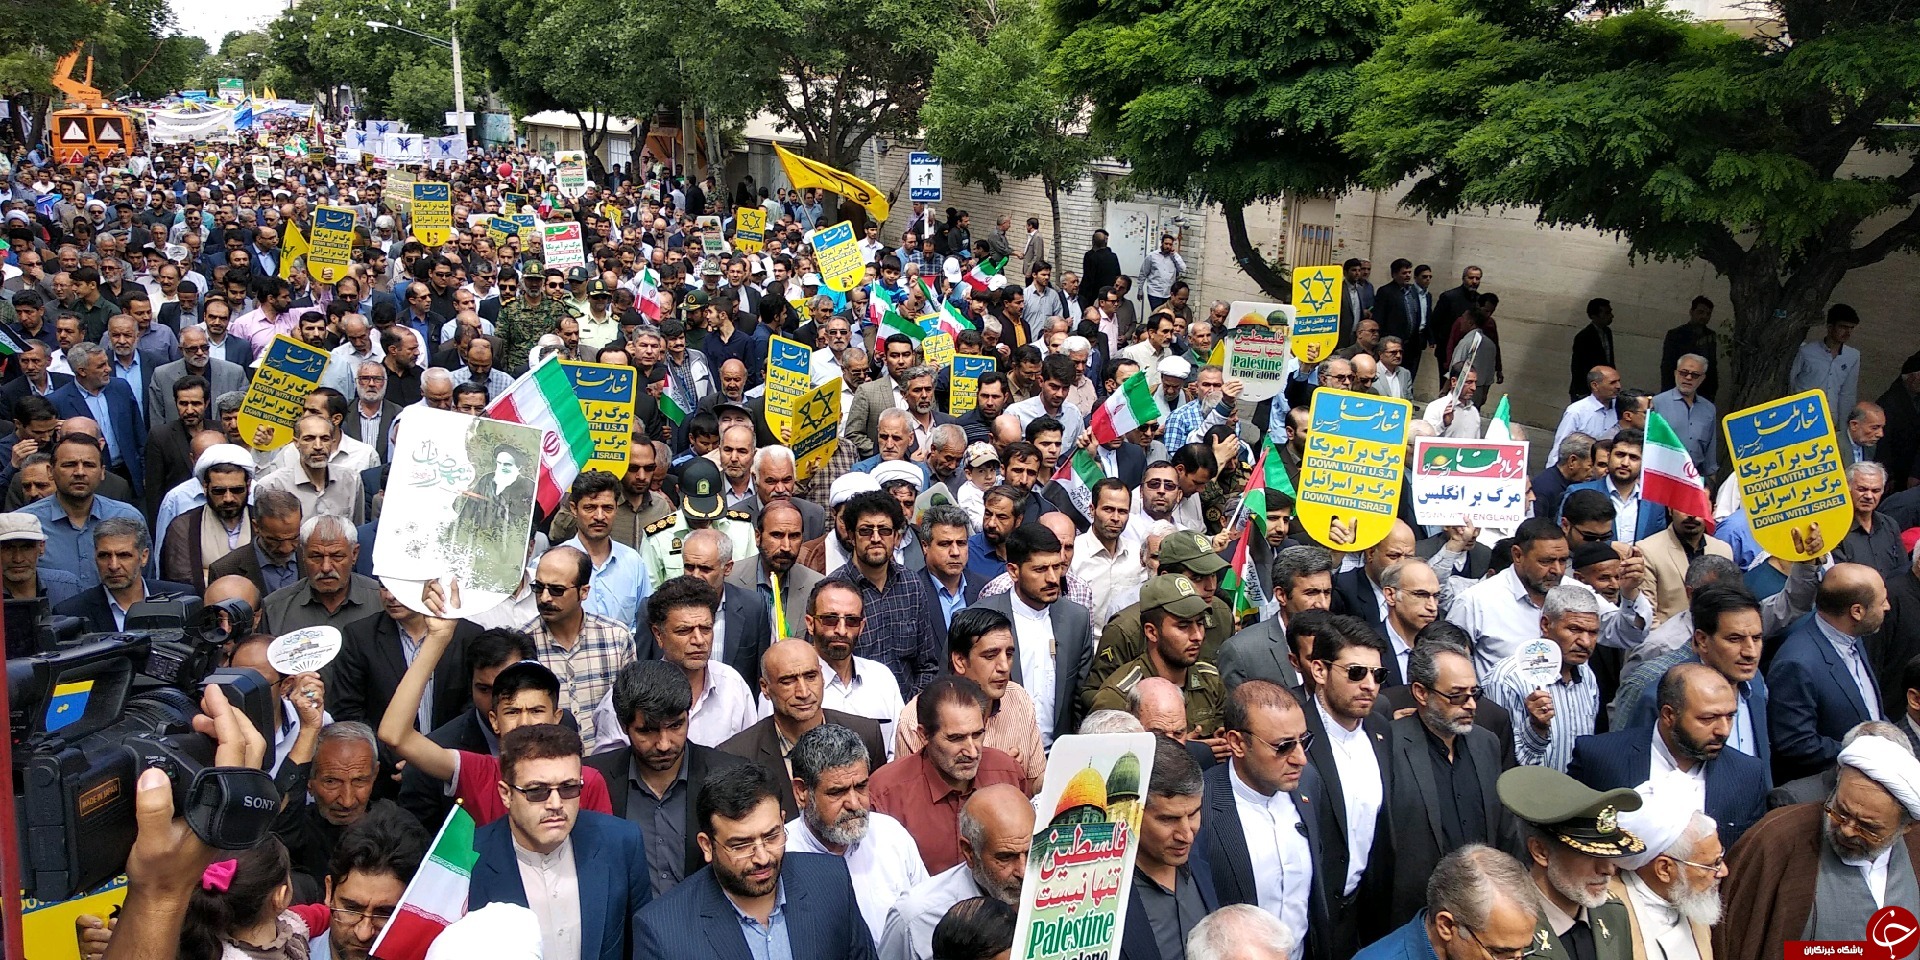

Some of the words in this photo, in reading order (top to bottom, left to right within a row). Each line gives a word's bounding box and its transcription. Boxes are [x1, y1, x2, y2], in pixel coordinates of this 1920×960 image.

[314, 230, 332, 240] آمریکا
[332, 234, 338, 242] بر
[339, 234, 350, 243] مرگ
[311, 247, 331, 255] اسرائیل
[1234, 329, 1284, 346] فلسطین
[1234, 346, 1261, 358] نیست
[1233, 356, 1282, 372] Palestine
[259, 369, 290, 386] آمریکا
[770, 369, 789, 383] آمریکا
[789, 376, 795, 386] بر
[1232, 369, 1238, 377] is
[1240, 370, 1254, 379] not
[1256, 370, 1280, 380] alone
[255, 383, 275, 397] DOWN
[276, 388, 290, 400] WITH
[287, 382, 295, 392] بر
[953, 379, 973, 390] آمریکا
[248, 393, 278, 409] اسرائیل
[276, 404, 285, 414] بر
[953, 397, 973, 407] اسرائیل
[245, 407, 261, 417] DOWN
[263, 412, 276, 422] WITH
[591, 409, 602, 420] بر
[605, 406, 630, 422] مرگ
[604, 436, 627, 448] مرگ
[1310, 436, 1356, 458] آمریکا
[1354, 449, 1368, 463] بر
[1370, 447, 1400, 468] مرگ
[1804, 443, 1834, 463] مرگ
[1309, 458, 1339, 470] DOWN
[1342, 463, 1366, 475] WITH
[1368, 467, 1394, 479] U.S.A
[1739, 449, 1785, 479] آمریکا
[1788, 454, 1801, 471] بر
[1304, 470, 1352, 492] اسرائیل
[1747, 479, 1778, 494] DOWN
[1782, 471, 1806, 484] WITH
[1808, 463, 1834, 476] U.S.A
[1814, 477, 1842, 494] مرگ
[1352, 482, 1365, 495] بر
[1368, 483, 1395, 499] مرگ
[1418, 485, 1465, 504] انگلیس
[1487, 485, 1521, 508] مرگ
[1800, 486, 1812, 502] بر
[1304, 492, 1332, 504] DOWN
[1333, 497, 1356, 508] WITH
[1358, 501, 1389, 514] ISRAEL
[1469, 492, 1482, 506] بر
[1750, 487, 1797, 515] اسرائیل
[1755, 513, 1784, 527] DOWN
[1786, 506, 1810, 518] WITH
[1812, 496, 1844, 512] ISRAEL
[244, 796, 275, 810] SONY
[1041, 821, 1128, 881] فلسطین
[1035, 872, 1087, 914] نیست
[1091, 868, 1122, 908] تنها
[1027, 910, 1114, 959] Palestine
